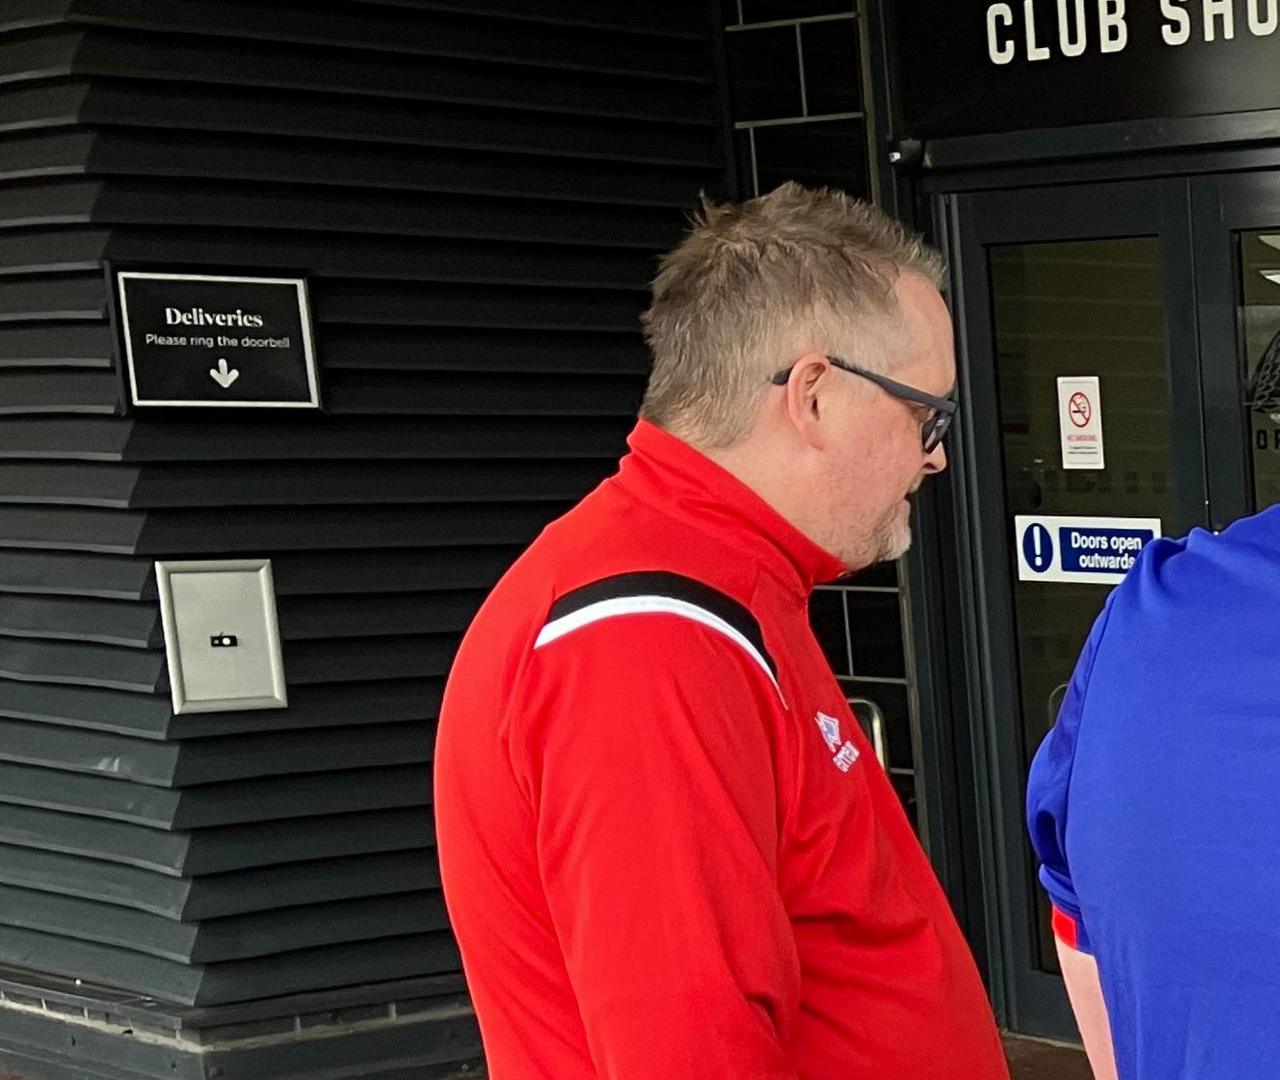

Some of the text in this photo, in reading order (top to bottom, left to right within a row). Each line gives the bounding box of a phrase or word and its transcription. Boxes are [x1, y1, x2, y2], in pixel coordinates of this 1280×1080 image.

[986, 0, 1128, 65] CLUB
[165, 308, 263, 327] Deliveries
[145, 334, 290, 348] Please ring the doorbell
[1071, 532, 1142, 552] Doors open
[1079, 554, 1135, 570] outwards
